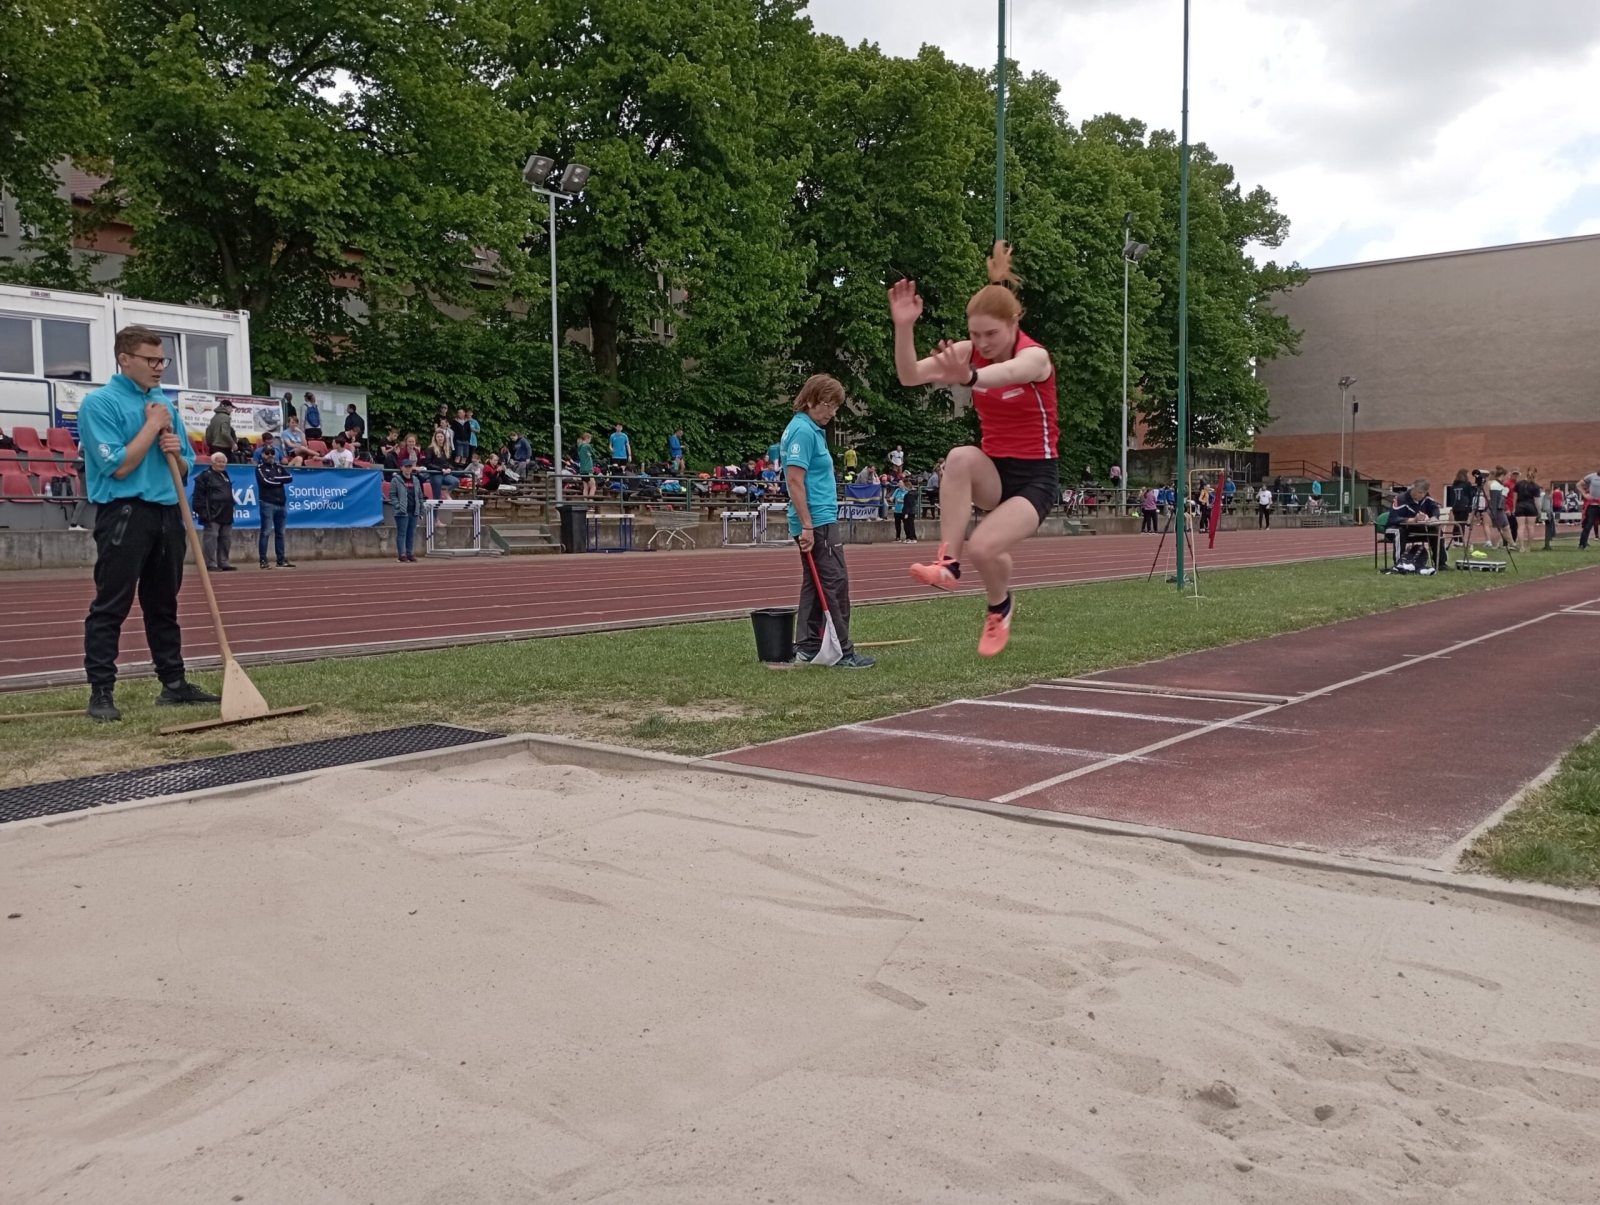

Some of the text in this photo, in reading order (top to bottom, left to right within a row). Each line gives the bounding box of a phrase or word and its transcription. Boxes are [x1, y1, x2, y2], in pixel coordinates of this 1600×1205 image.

[231, 484, 257, 506] KÁ
[288, 485, 348, 499] Sportujeme
[288, 499, 344, 512] se Spořkou
